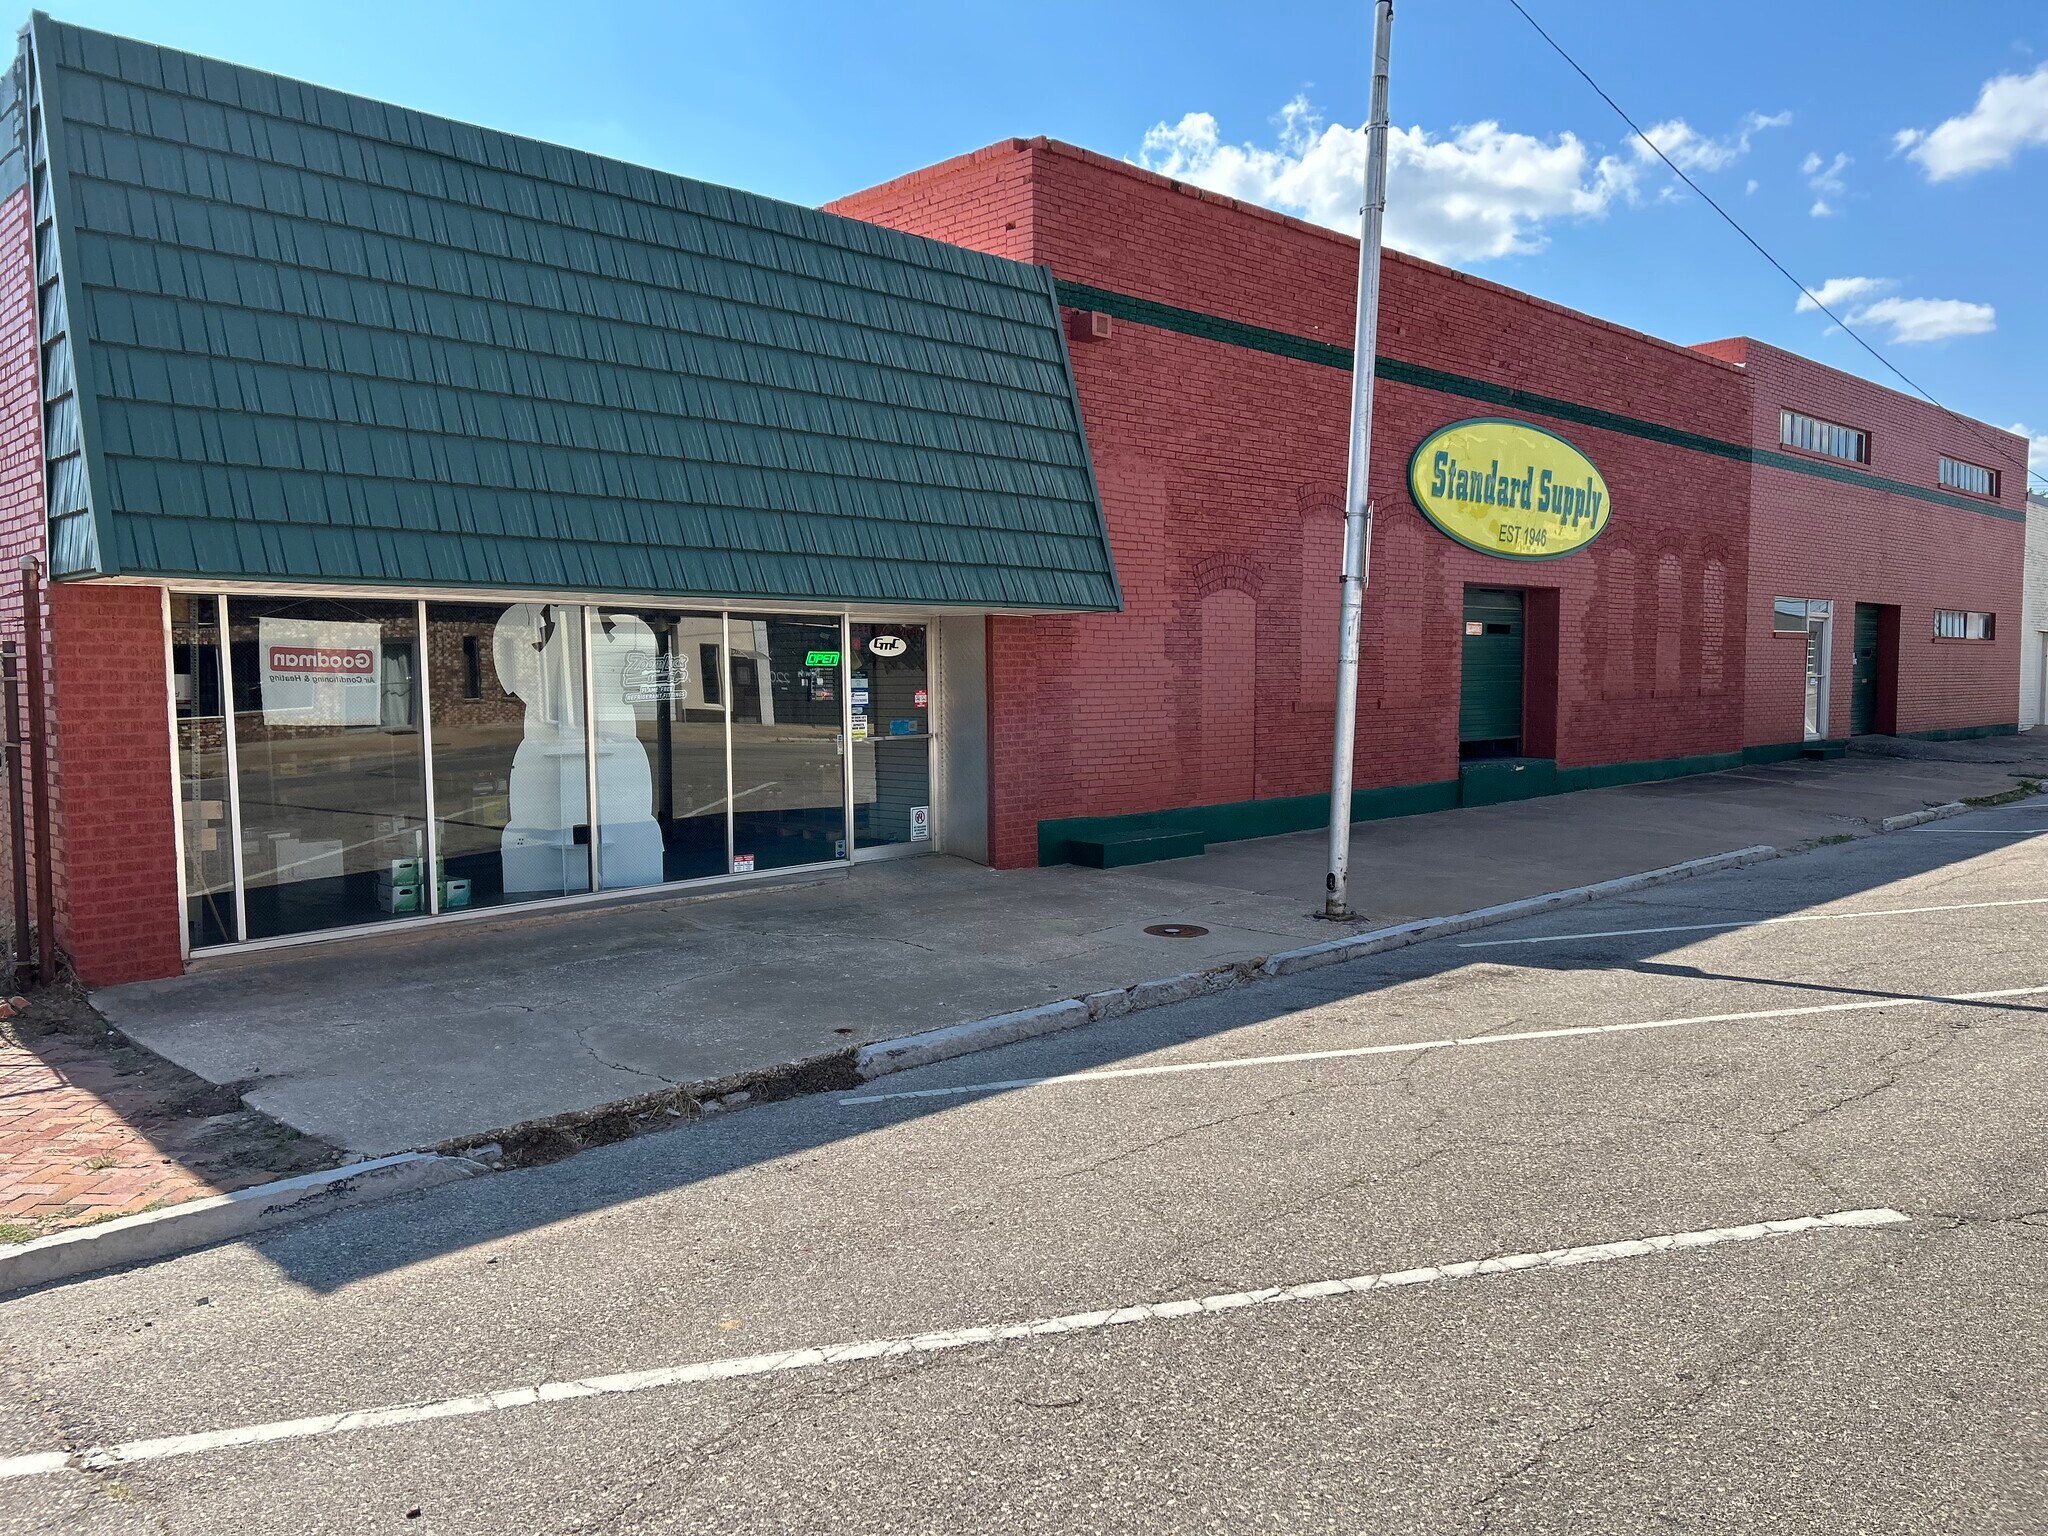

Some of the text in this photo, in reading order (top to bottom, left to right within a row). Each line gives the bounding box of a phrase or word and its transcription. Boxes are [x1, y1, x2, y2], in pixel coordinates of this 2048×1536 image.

[1431, 450, 1602, 530] Standard Supply
[1499, 524, 1547, 546] EST 1946
[807, 654, 838, 664] OPEN
